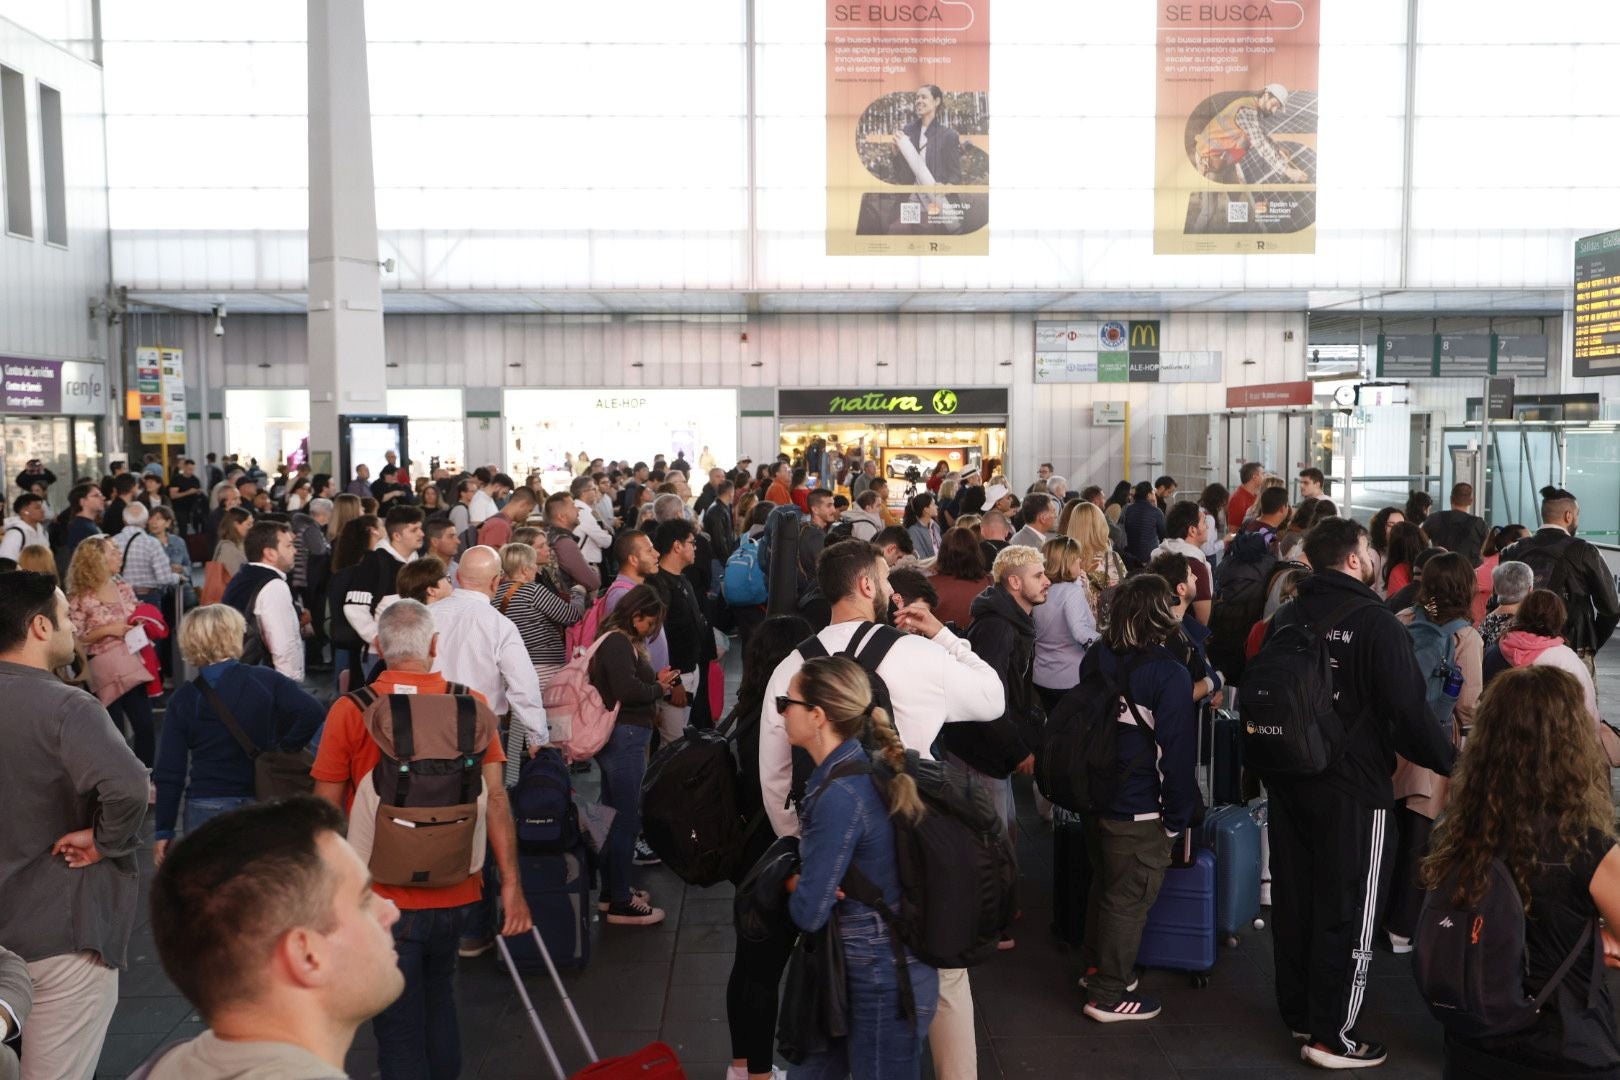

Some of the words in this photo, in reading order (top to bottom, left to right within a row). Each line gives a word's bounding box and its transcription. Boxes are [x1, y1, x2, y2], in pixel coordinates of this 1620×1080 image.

[835, 5, 862, 22] SE
[868, 5, 942, 22] BUSCA
[1166, 5, 1192, 22] SE
[1200, 5, 1272, 22] BUSCA
[1387, 341, 1393, 350] 9
[1443, 341, 1449, 350] 8
[1500, 341, 1506, 349] 7
[66, 374, 101, 405] renfe
[829, 392, 923, 412] natura
